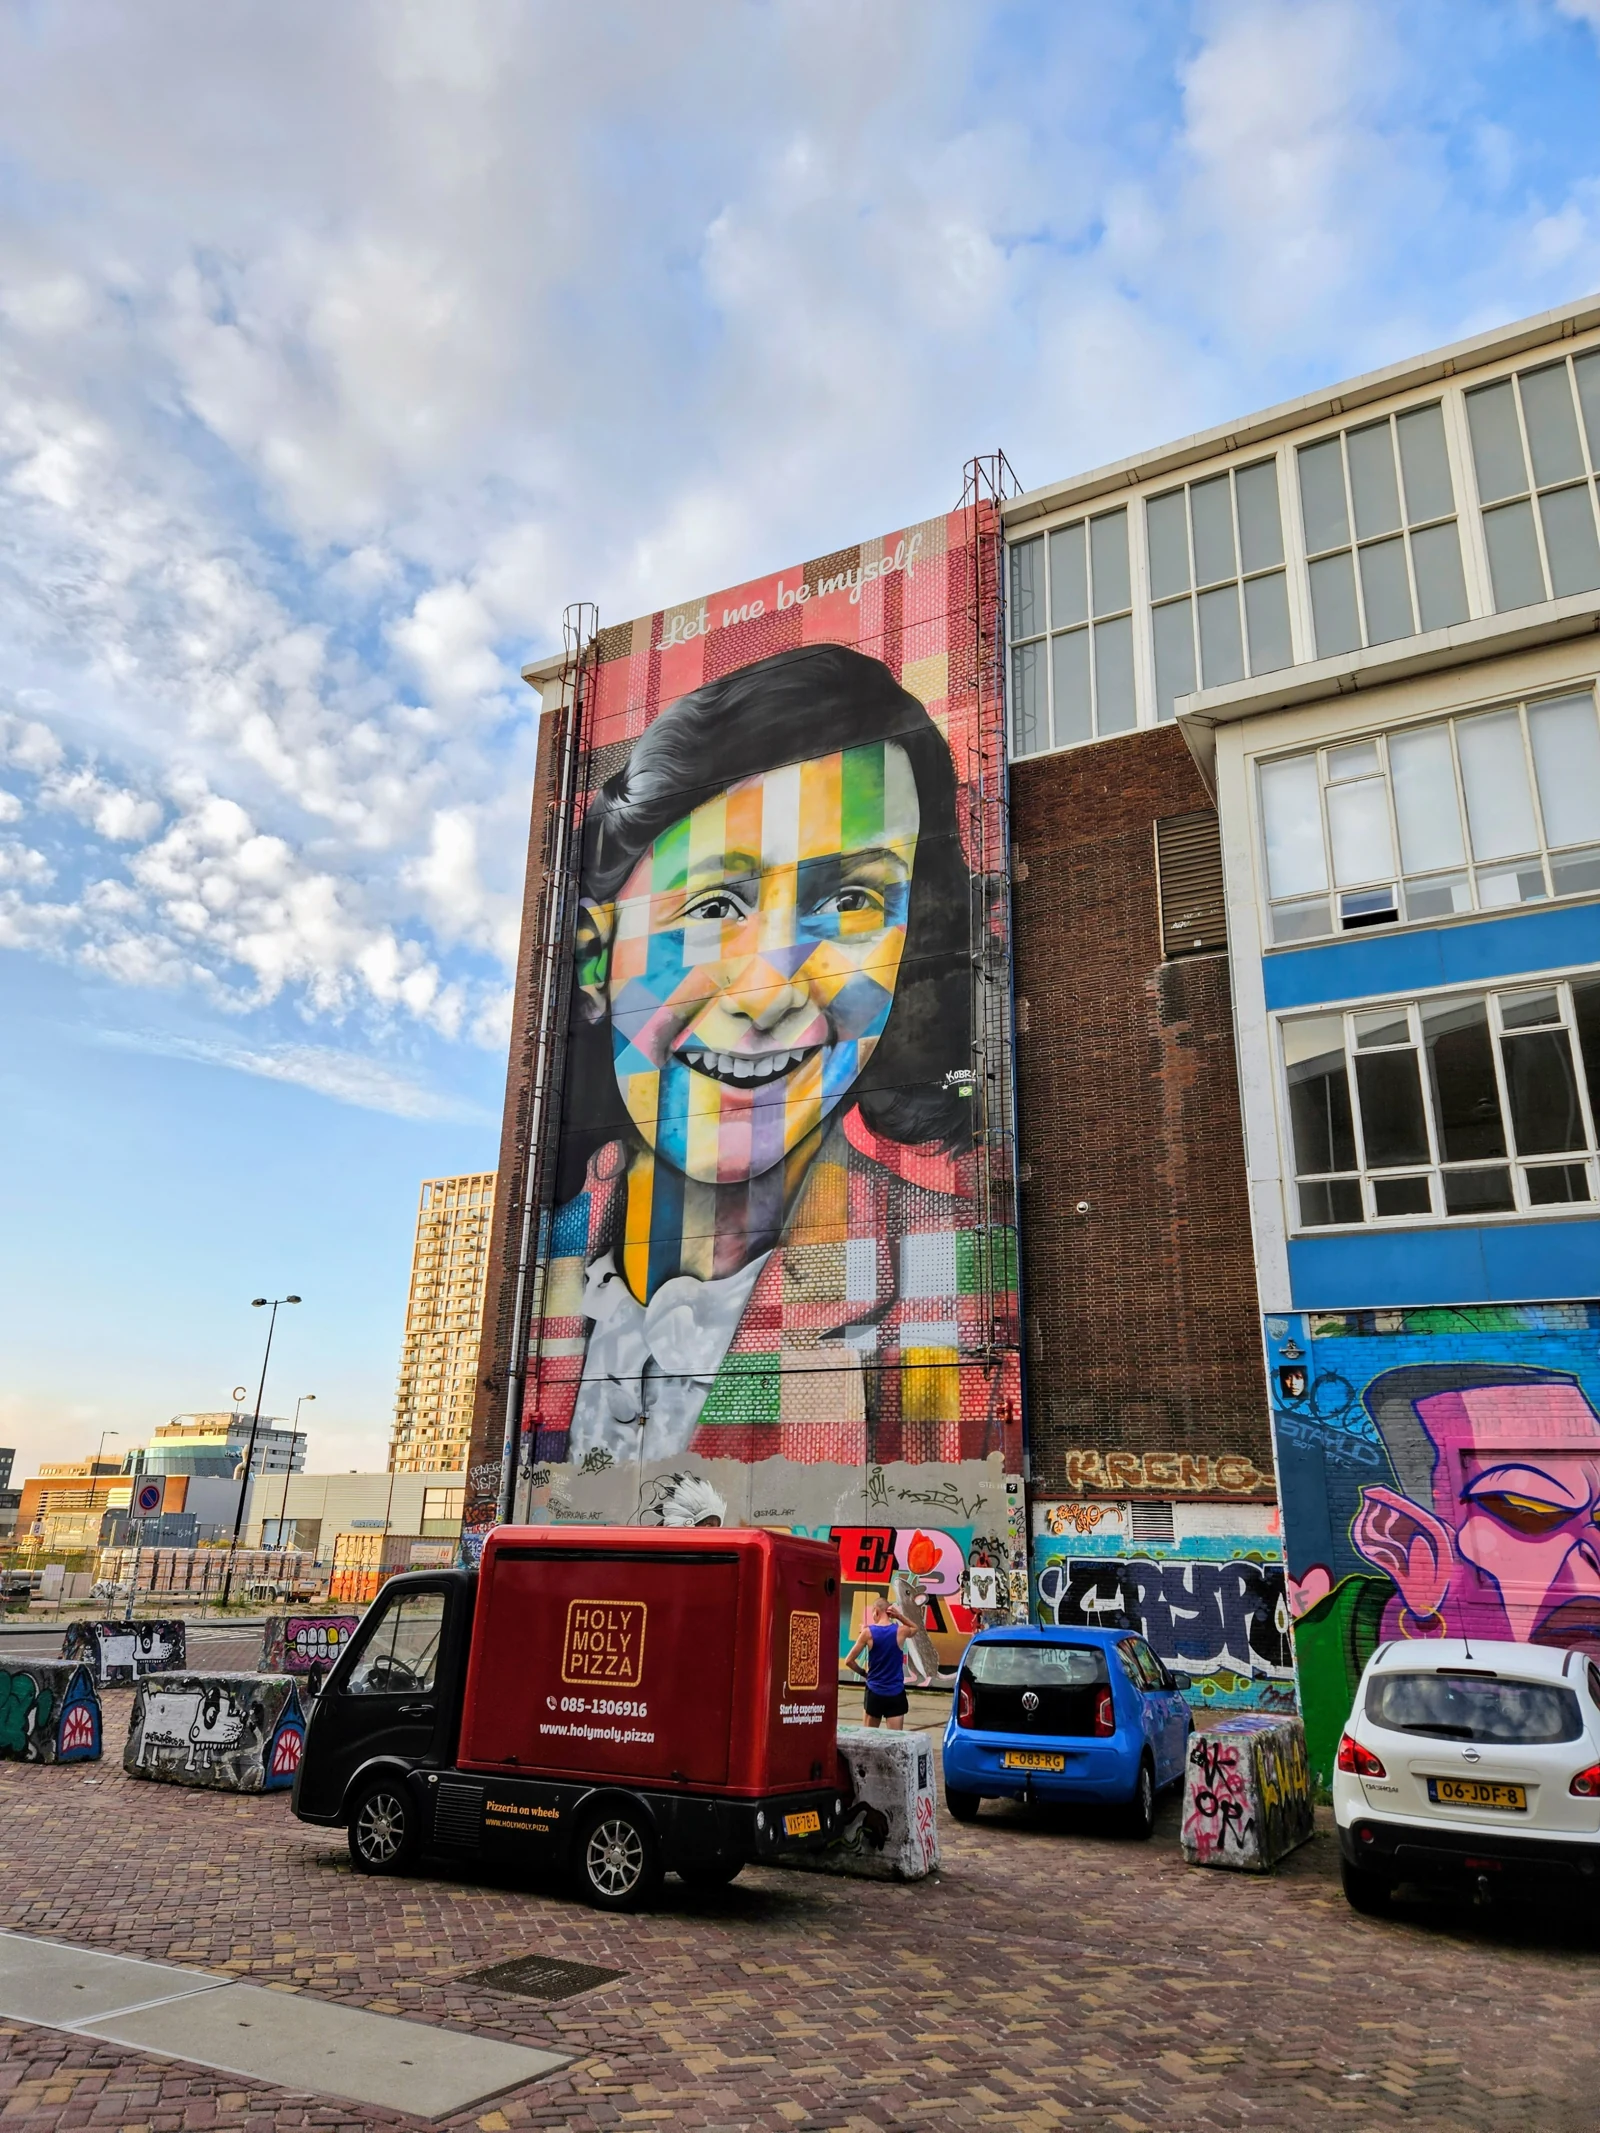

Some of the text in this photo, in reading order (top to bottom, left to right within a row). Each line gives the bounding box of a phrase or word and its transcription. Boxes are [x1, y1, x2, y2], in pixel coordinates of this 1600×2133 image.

[655, 532, 923, 651] Let me be myself
[575, 1609, 632, 1630] HOLY
[573, 1631, 631, 1653] MOLY
[570, 1653, 632, 1676] PIZZA
[560, 1697, 648, 1717] 085-1306916
[780, 1703, 826, 1716] Start de experience
[783, 1713, 823, 1725] www.holymoly.pizza
[540, 1723, 655, 1743] www.holymoly.pizza
[1008, 1752, 1061, 1768] L-083-RG
[1365, 1783, 1399, 1793] QASHQAI
[1442, 1782, 1519, 1805] 06-JDF-8
[486, 1800, 560, 1819] Pizzeria on wheels
[485, 1818, 550, 1832] WWW.HOLYMOLY.PIZZA
